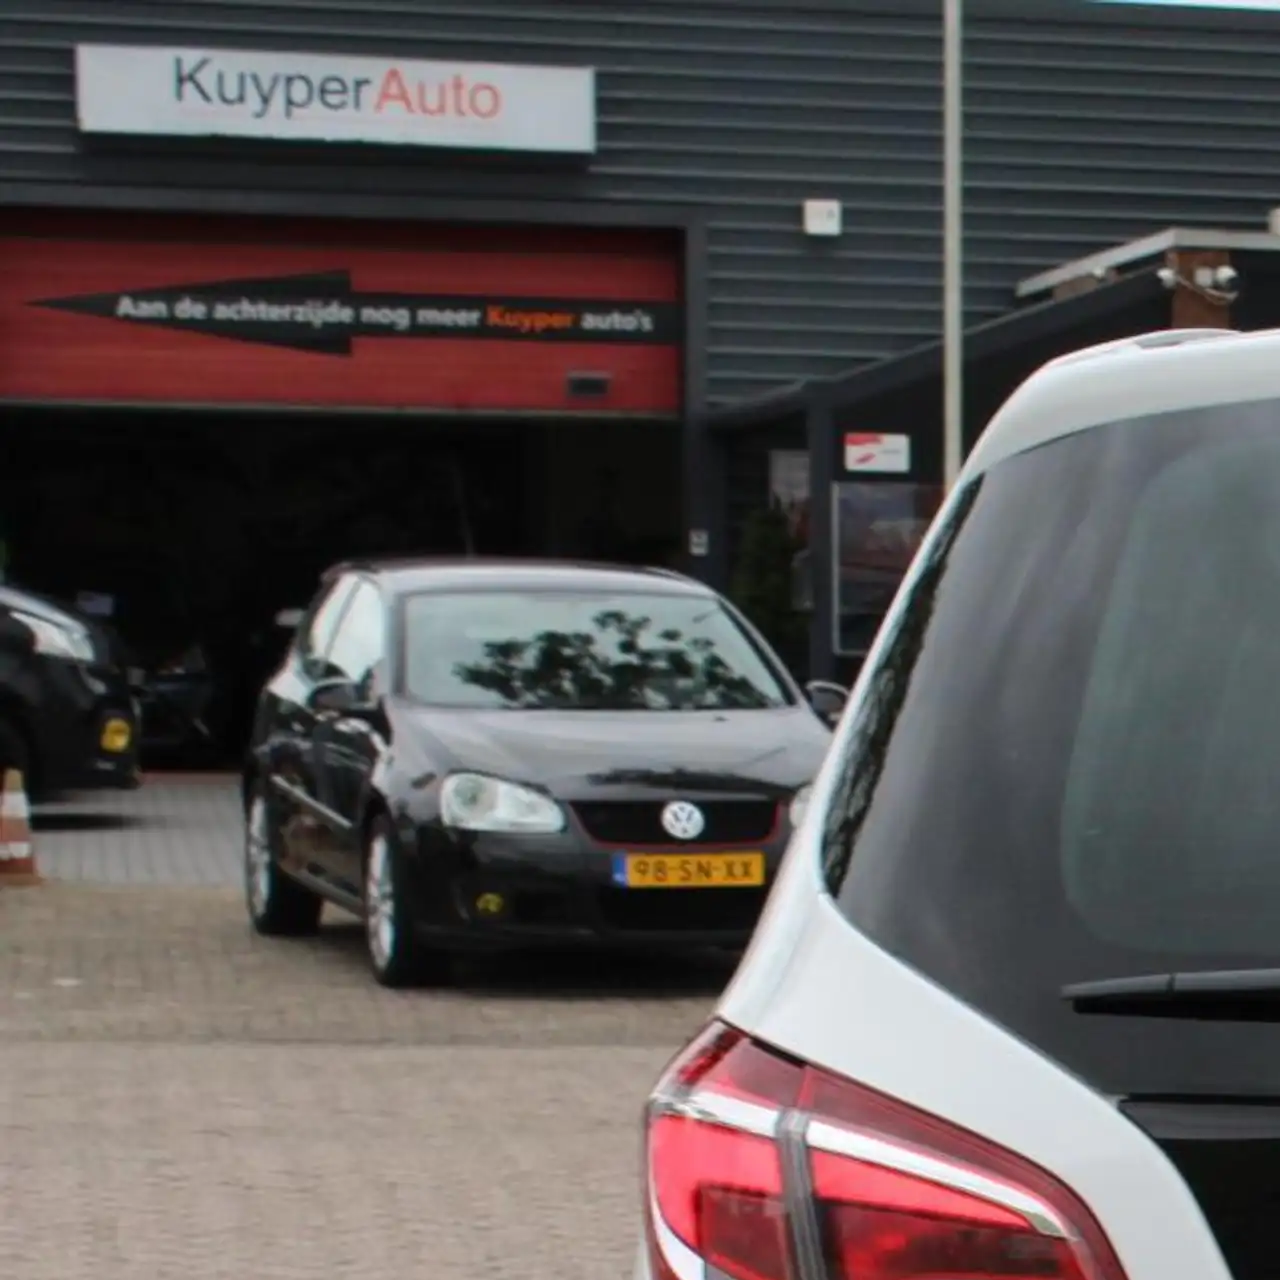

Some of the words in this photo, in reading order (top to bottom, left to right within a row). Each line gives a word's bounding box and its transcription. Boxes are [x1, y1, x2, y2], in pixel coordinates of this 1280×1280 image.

[172, 55, 504, 119] KuyperAuto
[116, 296, 168, 318] Aan
[174, 297, 208, 320] de
[213, 298, 354, 328] achterzijde
[360, 306, 411, 330] nog
[417, 308, 481, 326] meer
[487, 305, 573, 332] Kuyper
[581, 309, 654, 332] auto's
